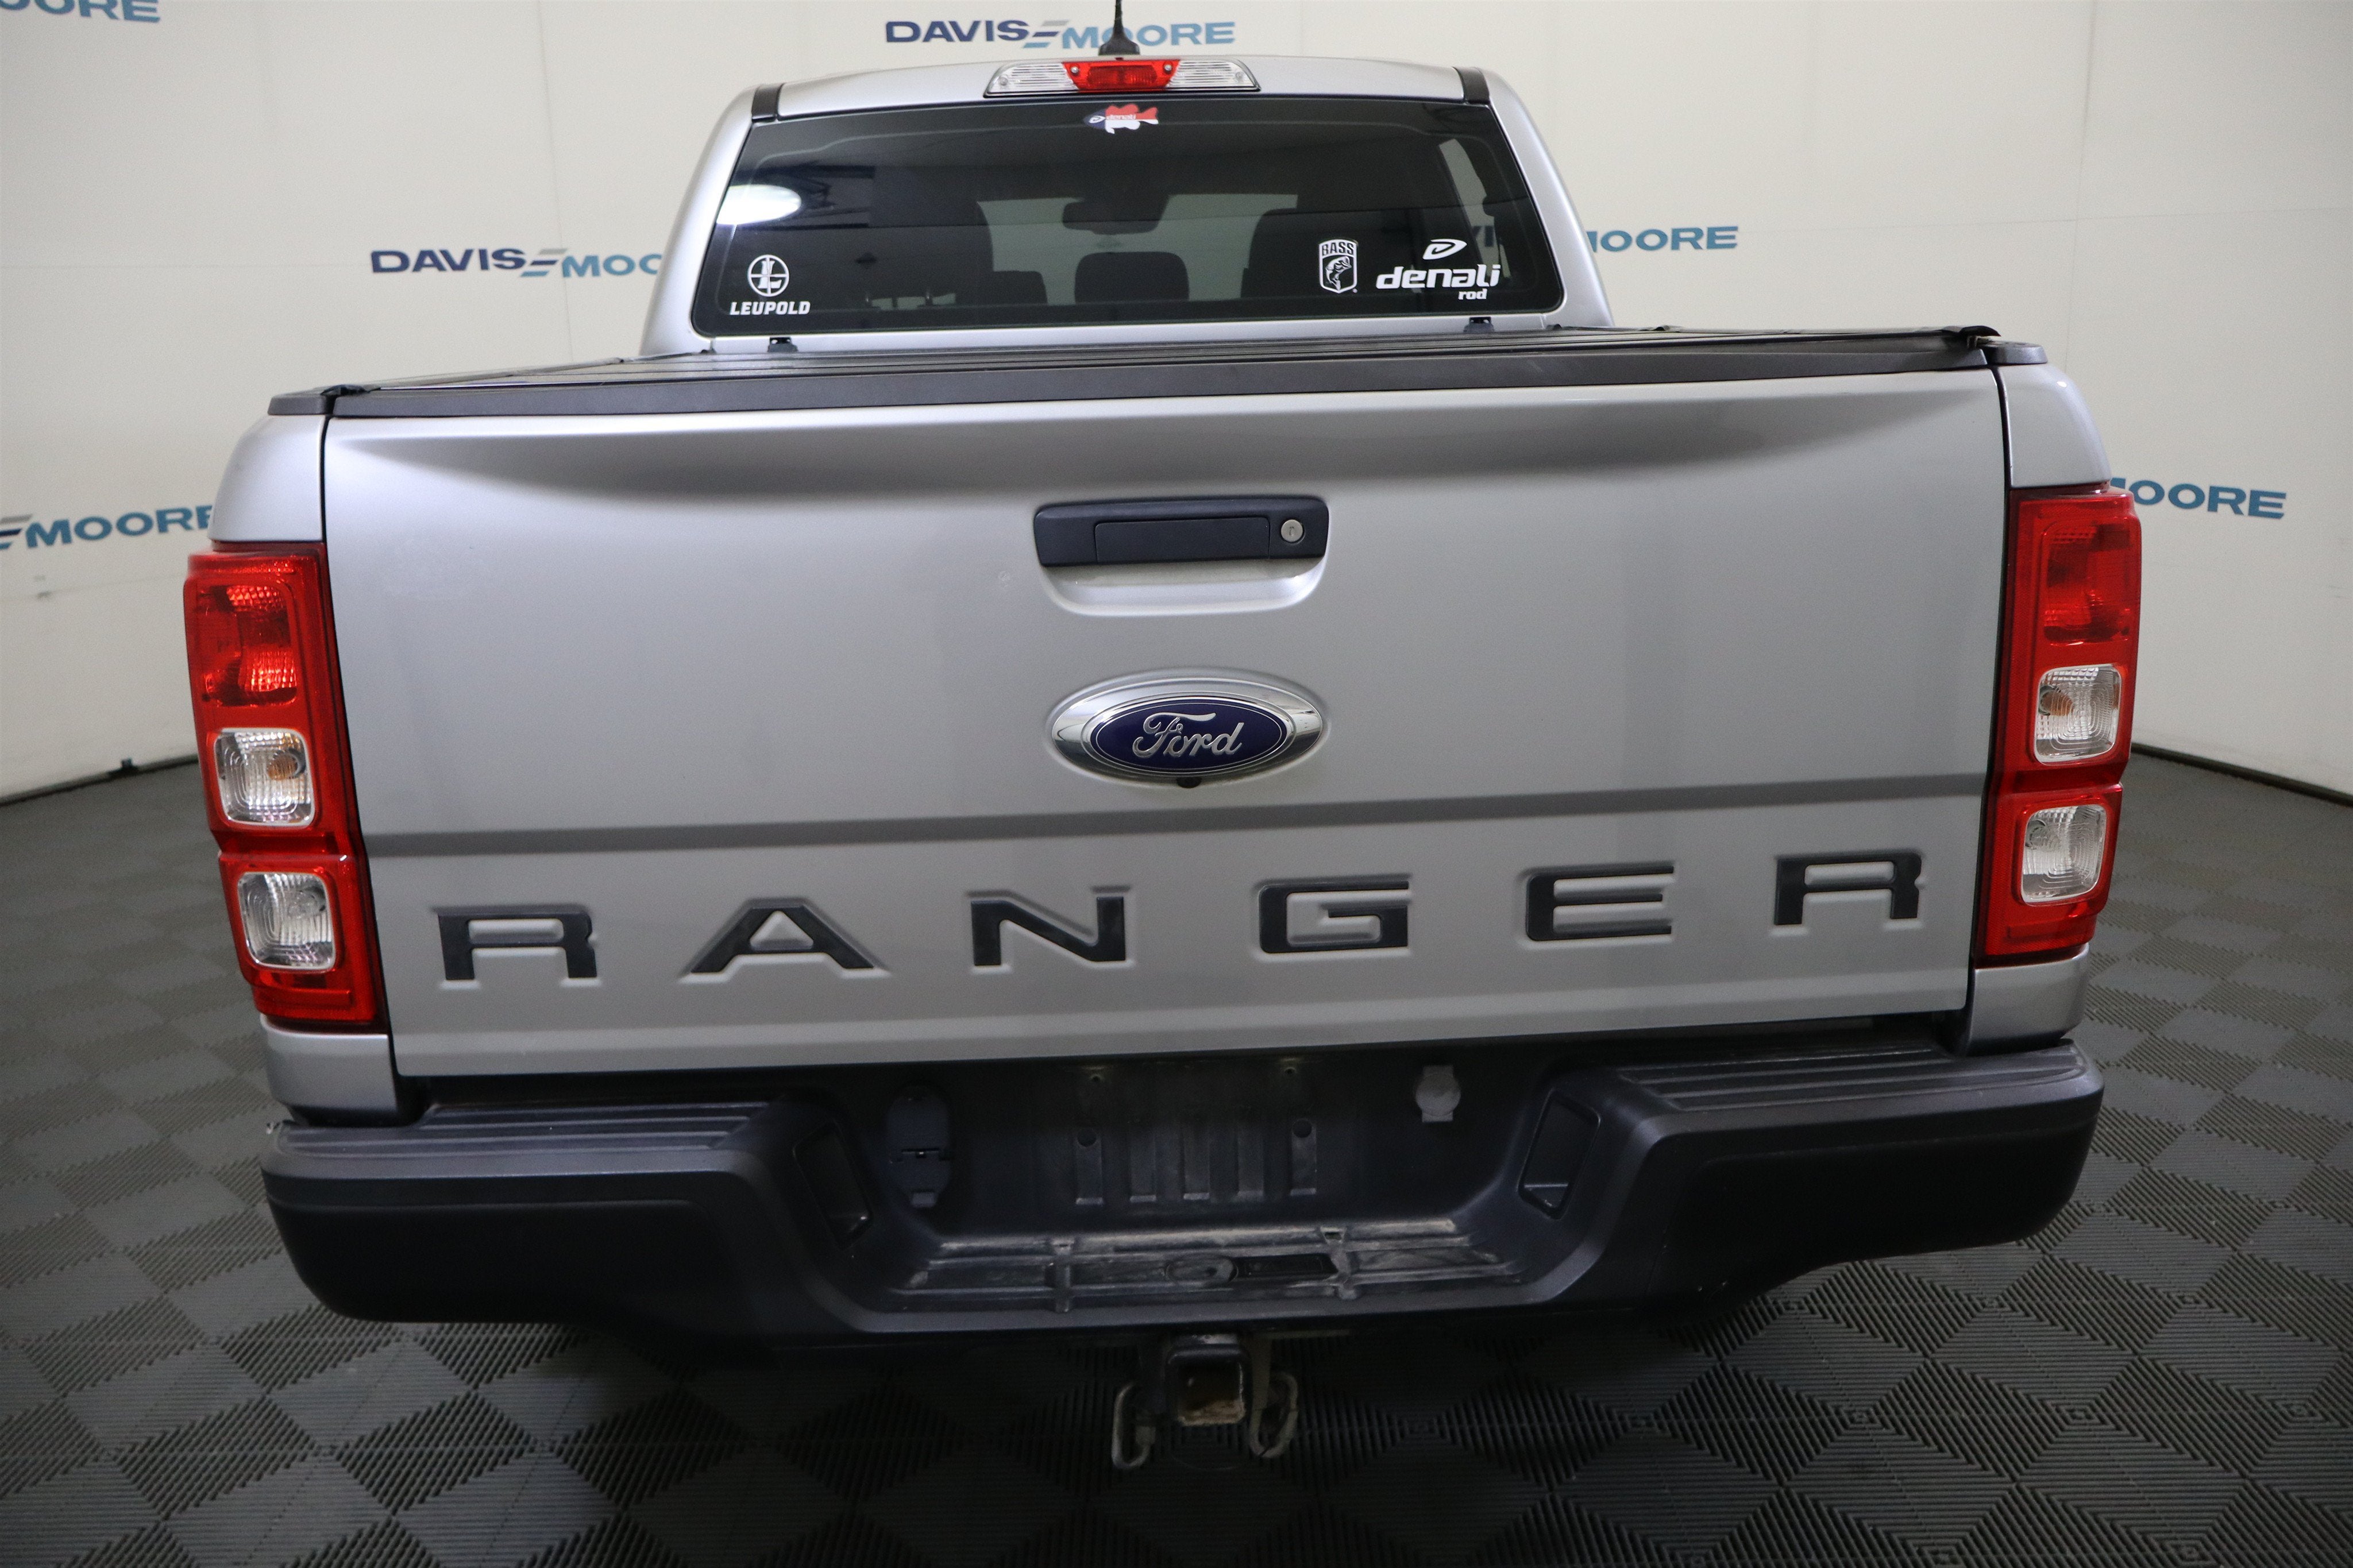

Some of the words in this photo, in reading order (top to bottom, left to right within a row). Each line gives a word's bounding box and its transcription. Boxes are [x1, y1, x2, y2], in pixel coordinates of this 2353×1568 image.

[886, 20, 1029, 43] DAVIS
[371, 248, 526, 273] DAVIS
[1322, 242, 1354, 256] BASS
[1376, 264, 1500, 289] denali
[1458, 288, 1487, 300] rod
[730, 301, 811, 315] LEUPOLD
[2111, 477, 2286, 519] OORE
[1133, 712, 1244, 758] Ford
[438, 851, 1923, 982] RANGER
